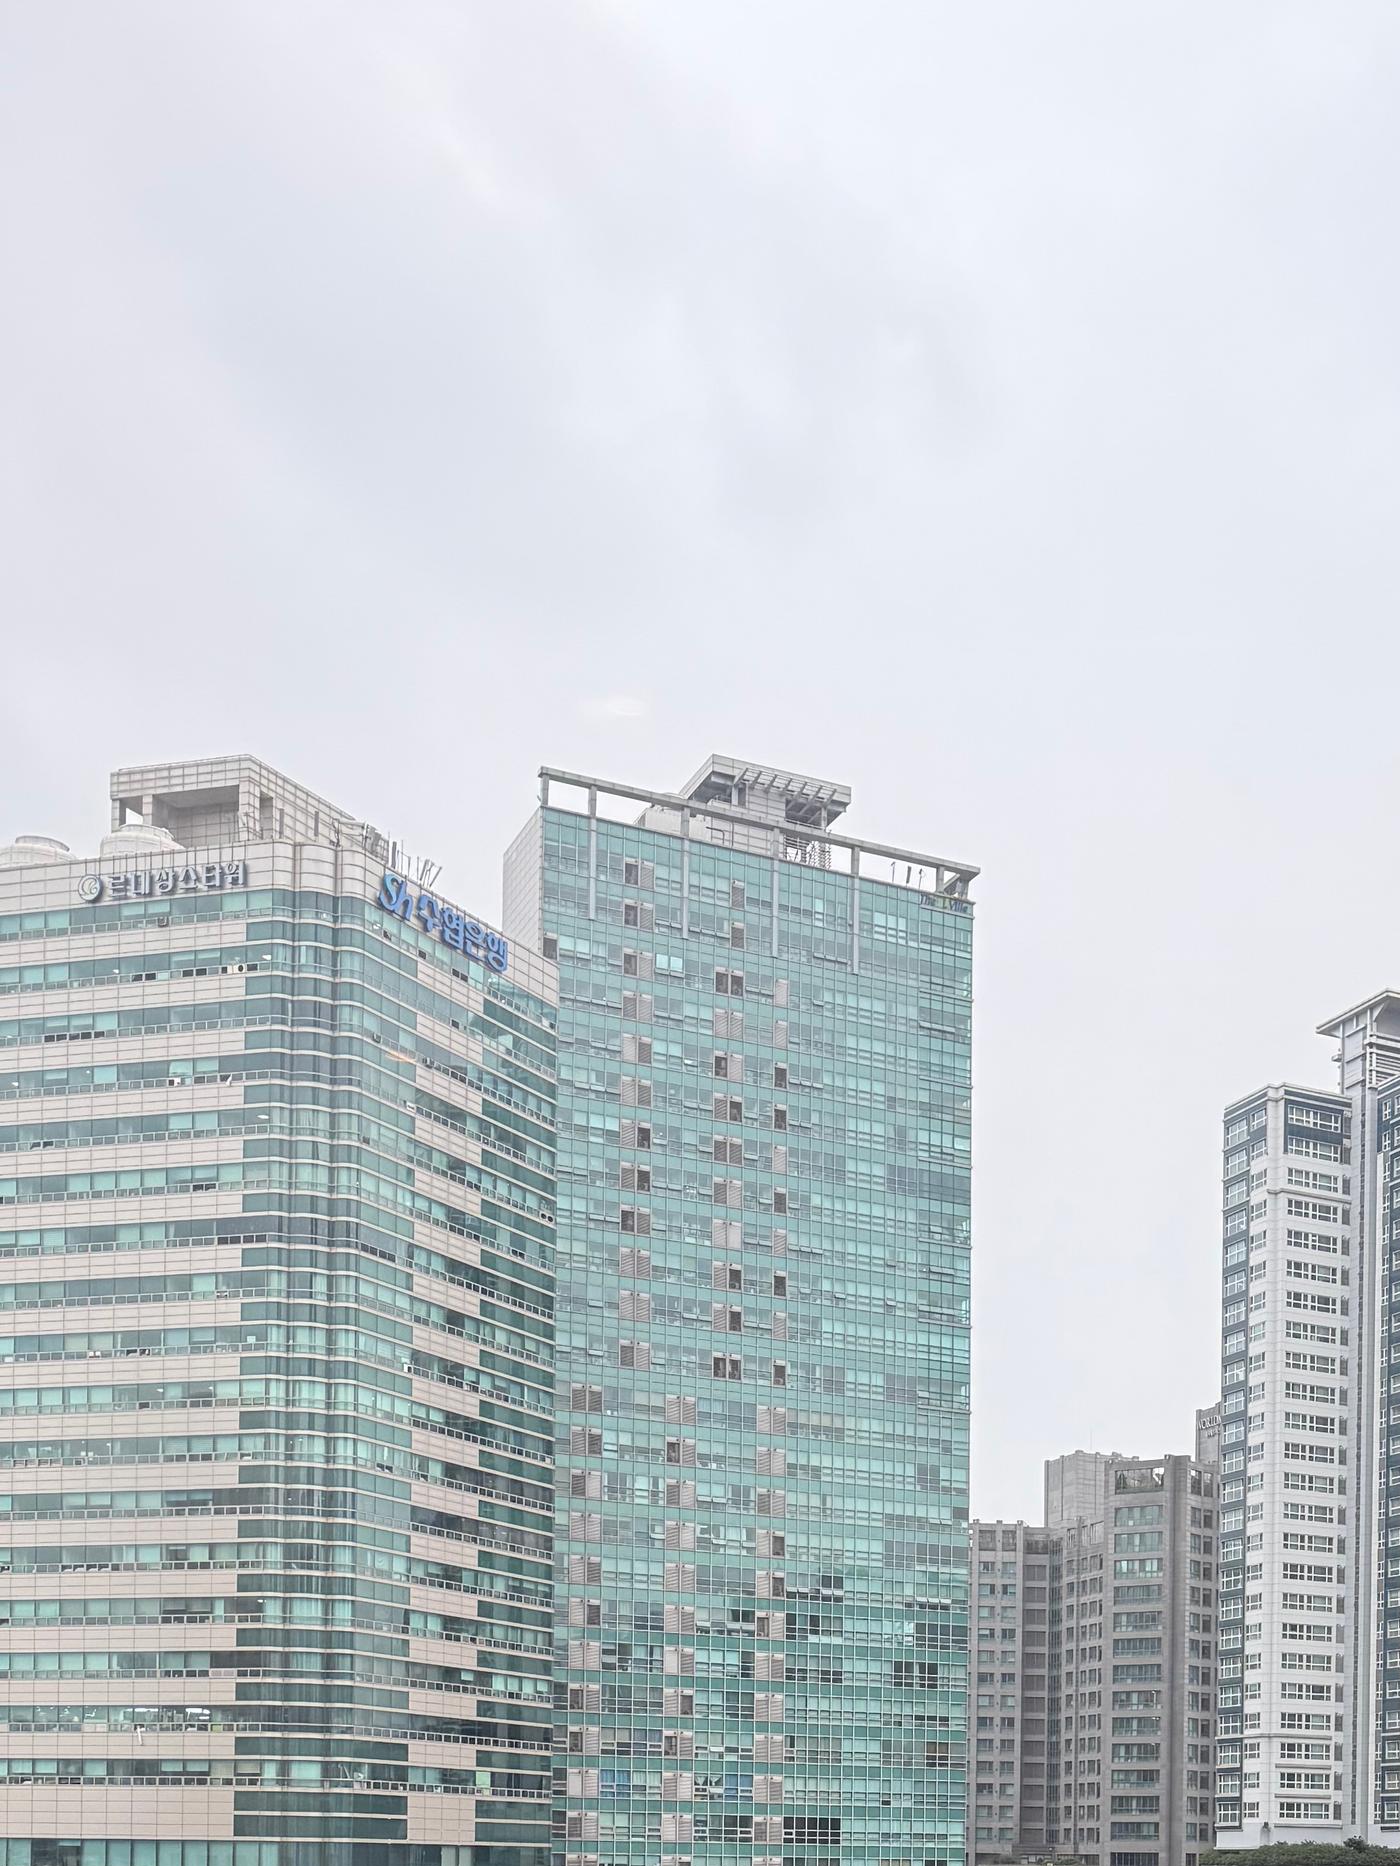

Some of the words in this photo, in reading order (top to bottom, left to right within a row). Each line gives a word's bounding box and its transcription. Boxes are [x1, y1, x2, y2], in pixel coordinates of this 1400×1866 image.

[108, 861, 247, 898] 르네상스타워
[378, 873, 414, 922] Sh
[417, 894, 509, 973] 수협은행
